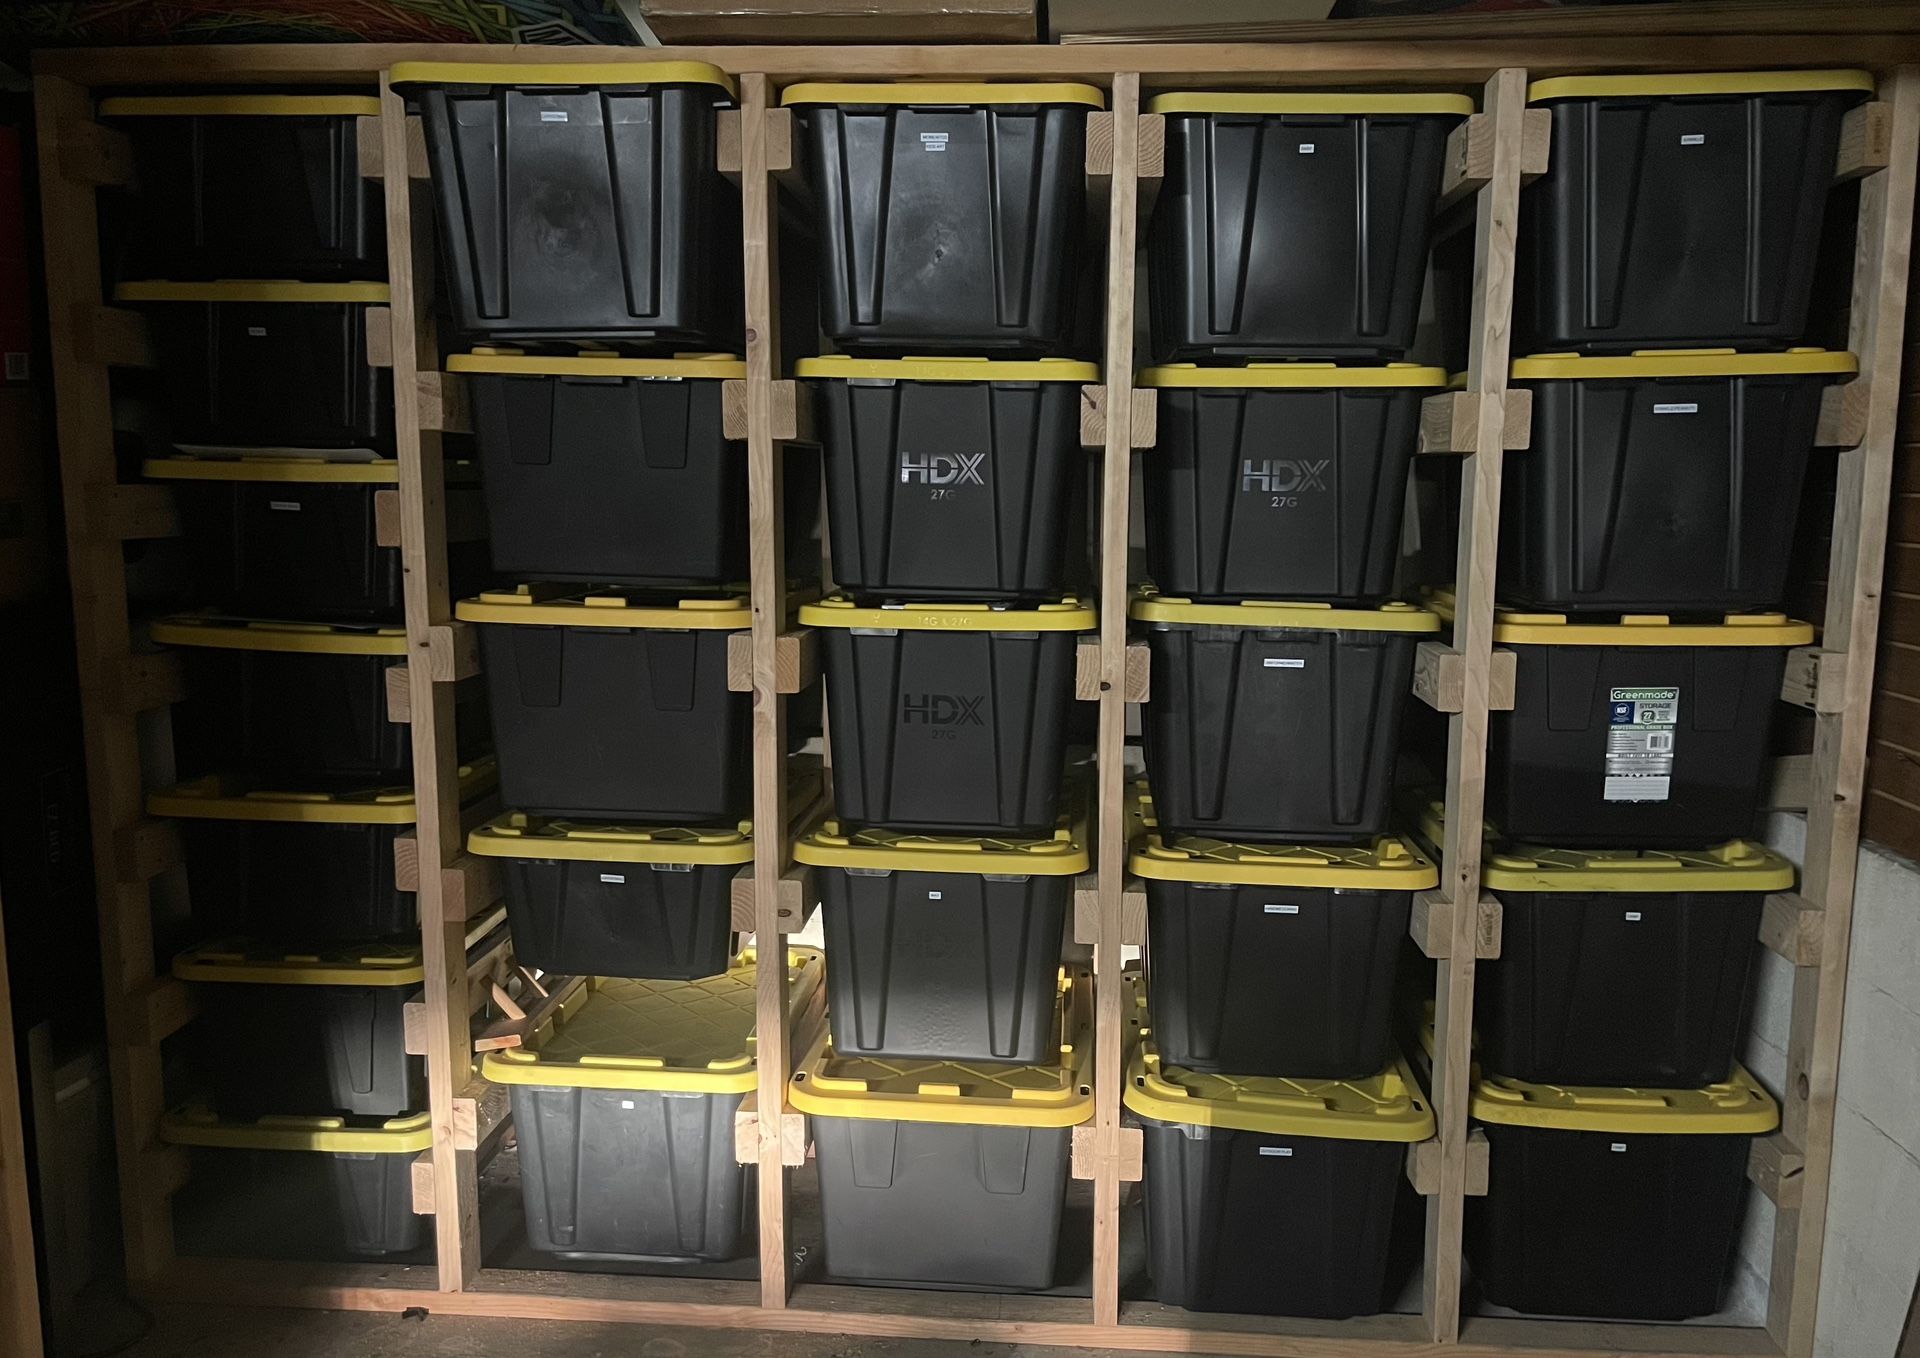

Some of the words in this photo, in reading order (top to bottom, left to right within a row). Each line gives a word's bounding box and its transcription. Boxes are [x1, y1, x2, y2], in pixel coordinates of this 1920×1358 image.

[901, 451, 986, 485] HDX
[1242, 459, 1330, 492] HDX
[1271, 496, 1298, 508] 27G
[1613, 690, 1674, 699] Greenmade
[903, 694, 985, 726] HDX
[1643, 711, 1652, 719] 27
[931, 729, 957, 740] 27G
